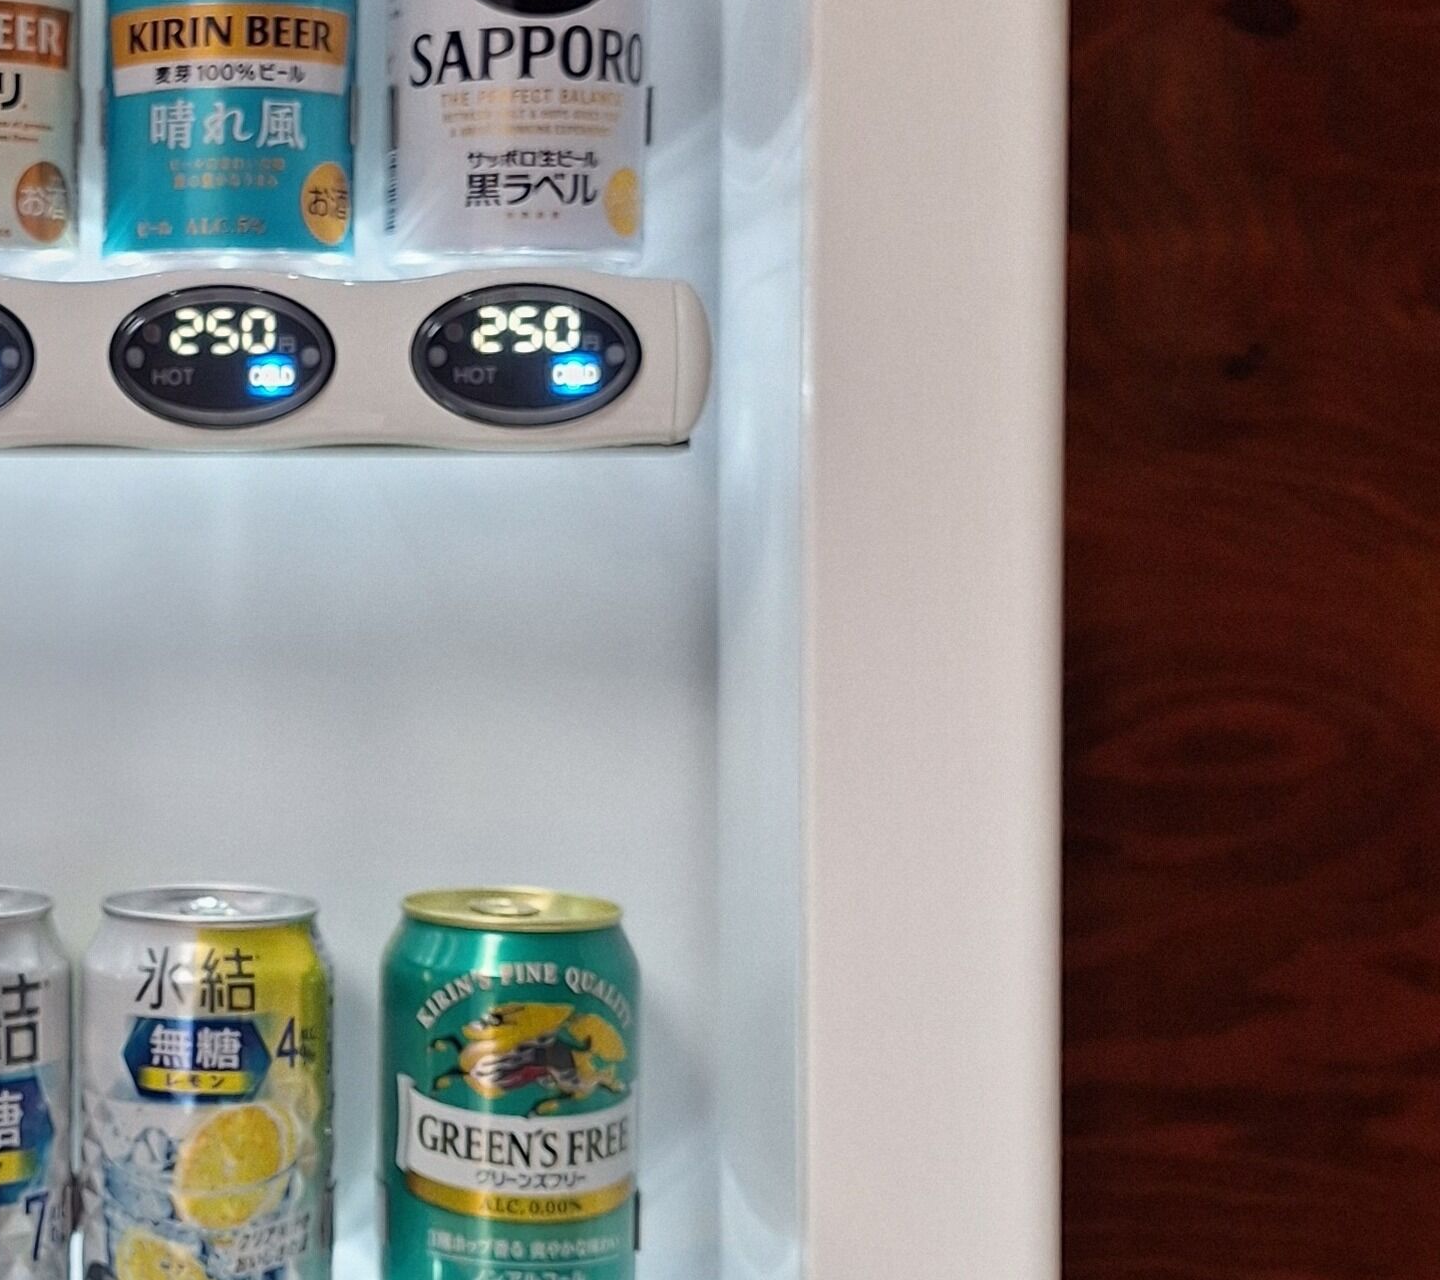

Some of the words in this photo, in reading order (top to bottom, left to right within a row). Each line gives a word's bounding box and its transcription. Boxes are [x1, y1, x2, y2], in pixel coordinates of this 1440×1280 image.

[128, 15, 234, 55] KIRIN
[245, 16, 333, 53] BEER
[410, 25, 643, 88] SAPPORO
[148, 97, 307, 150] 晴れ風
[466, 149, 600, 170] サッポロ生ビール
[465, 172, 599, 208] 黒ラベル
[169, 307, 277, 356] 250
[471, 305, 580, 354] 250
[135, 947, 256, 1013] 氷結
[501, 963, 558, 986] FINE
[150, 1024, 242, 1070] 無糖
[276, 1016, 299, 1068] 4
[166, 1074, 225, 1089] レモン
[418, 1114, 558, 1168] GREEN'S
[568, 1117, 628, 1167] FREE
[25, 1191, 49, 1262] 7
